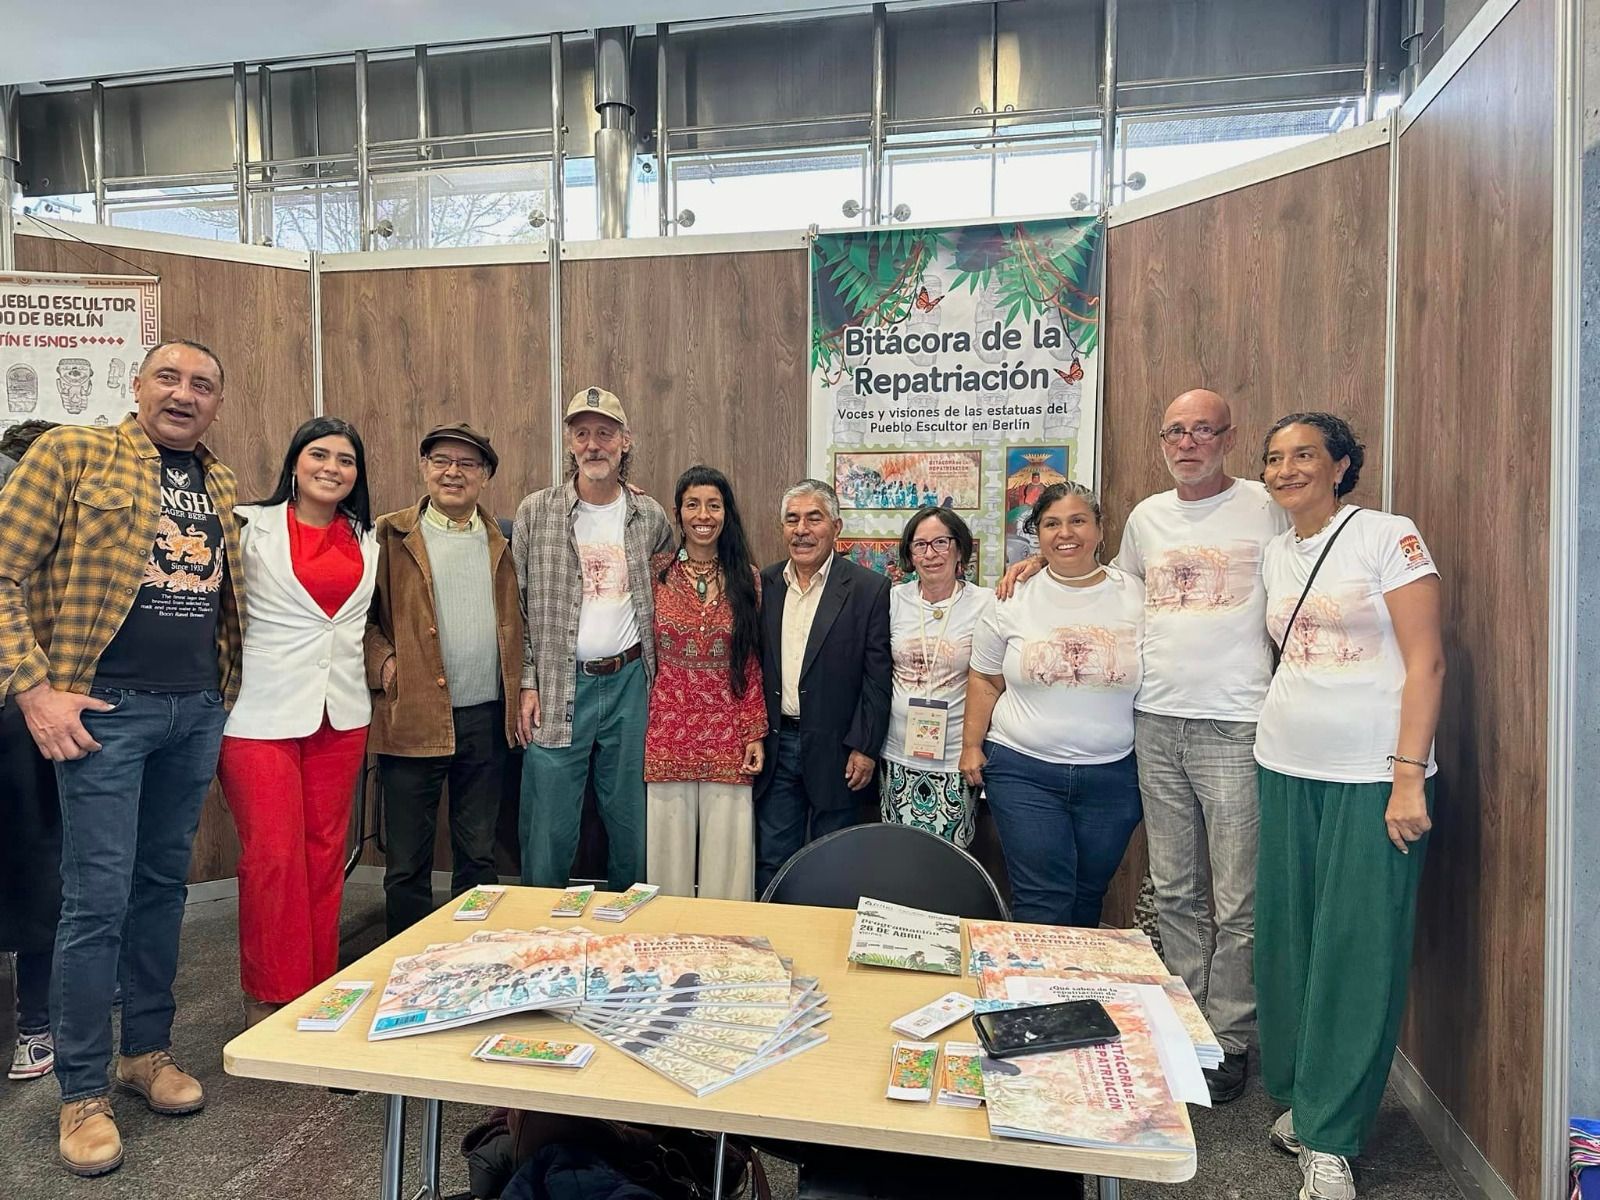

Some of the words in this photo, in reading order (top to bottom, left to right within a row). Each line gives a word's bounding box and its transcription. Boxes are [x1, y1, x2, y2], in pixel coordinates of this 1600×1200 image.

[53, 295, 137, 312] ESCULTOR
[18, 311, 41, 326] DE
[44, 311, 104, 328] BERLÍN
[22, 335, 32, 347] E
[34, 335, 79, 349] ISNOS
[845, 326, 971, 356] Bitácora
[981, 320, 1022, 352] de
[1033, 318, 1061, 349] la
[854, 360, 1049, 401] Repatriación
[837, 408, 875, 420] Voces
[877, 410, 886, 421] y
[889, 407, 941, 419] visiones
[944, 405, 961, 417] de
[964, 405, 983, 417] las
[987, 404, 1043, 416] estatuas
[1047, 402, 1069, 415] del
[870, 421, 913, 433] Pueblo
[916, 420, 969, 432] Escultor
[972, 422, 989, 431] en
[992, 418, 1031, 431] Berlín
[160, 485, 218, 515] NGH
[160, 506, 186, 518] LAGER
[187, 512, 207, 521] BEER
[171, 562, 189, 571] Since
[190, 564, 204, 572] 1933
[876, 926, 890, 934] DE
[892, 931, 925, 940] ABRIL
[1110, 1042, 1134, 1088] ITÁCORA
[1094, 1043, 1125, 1110] EPATRIACIÓN
